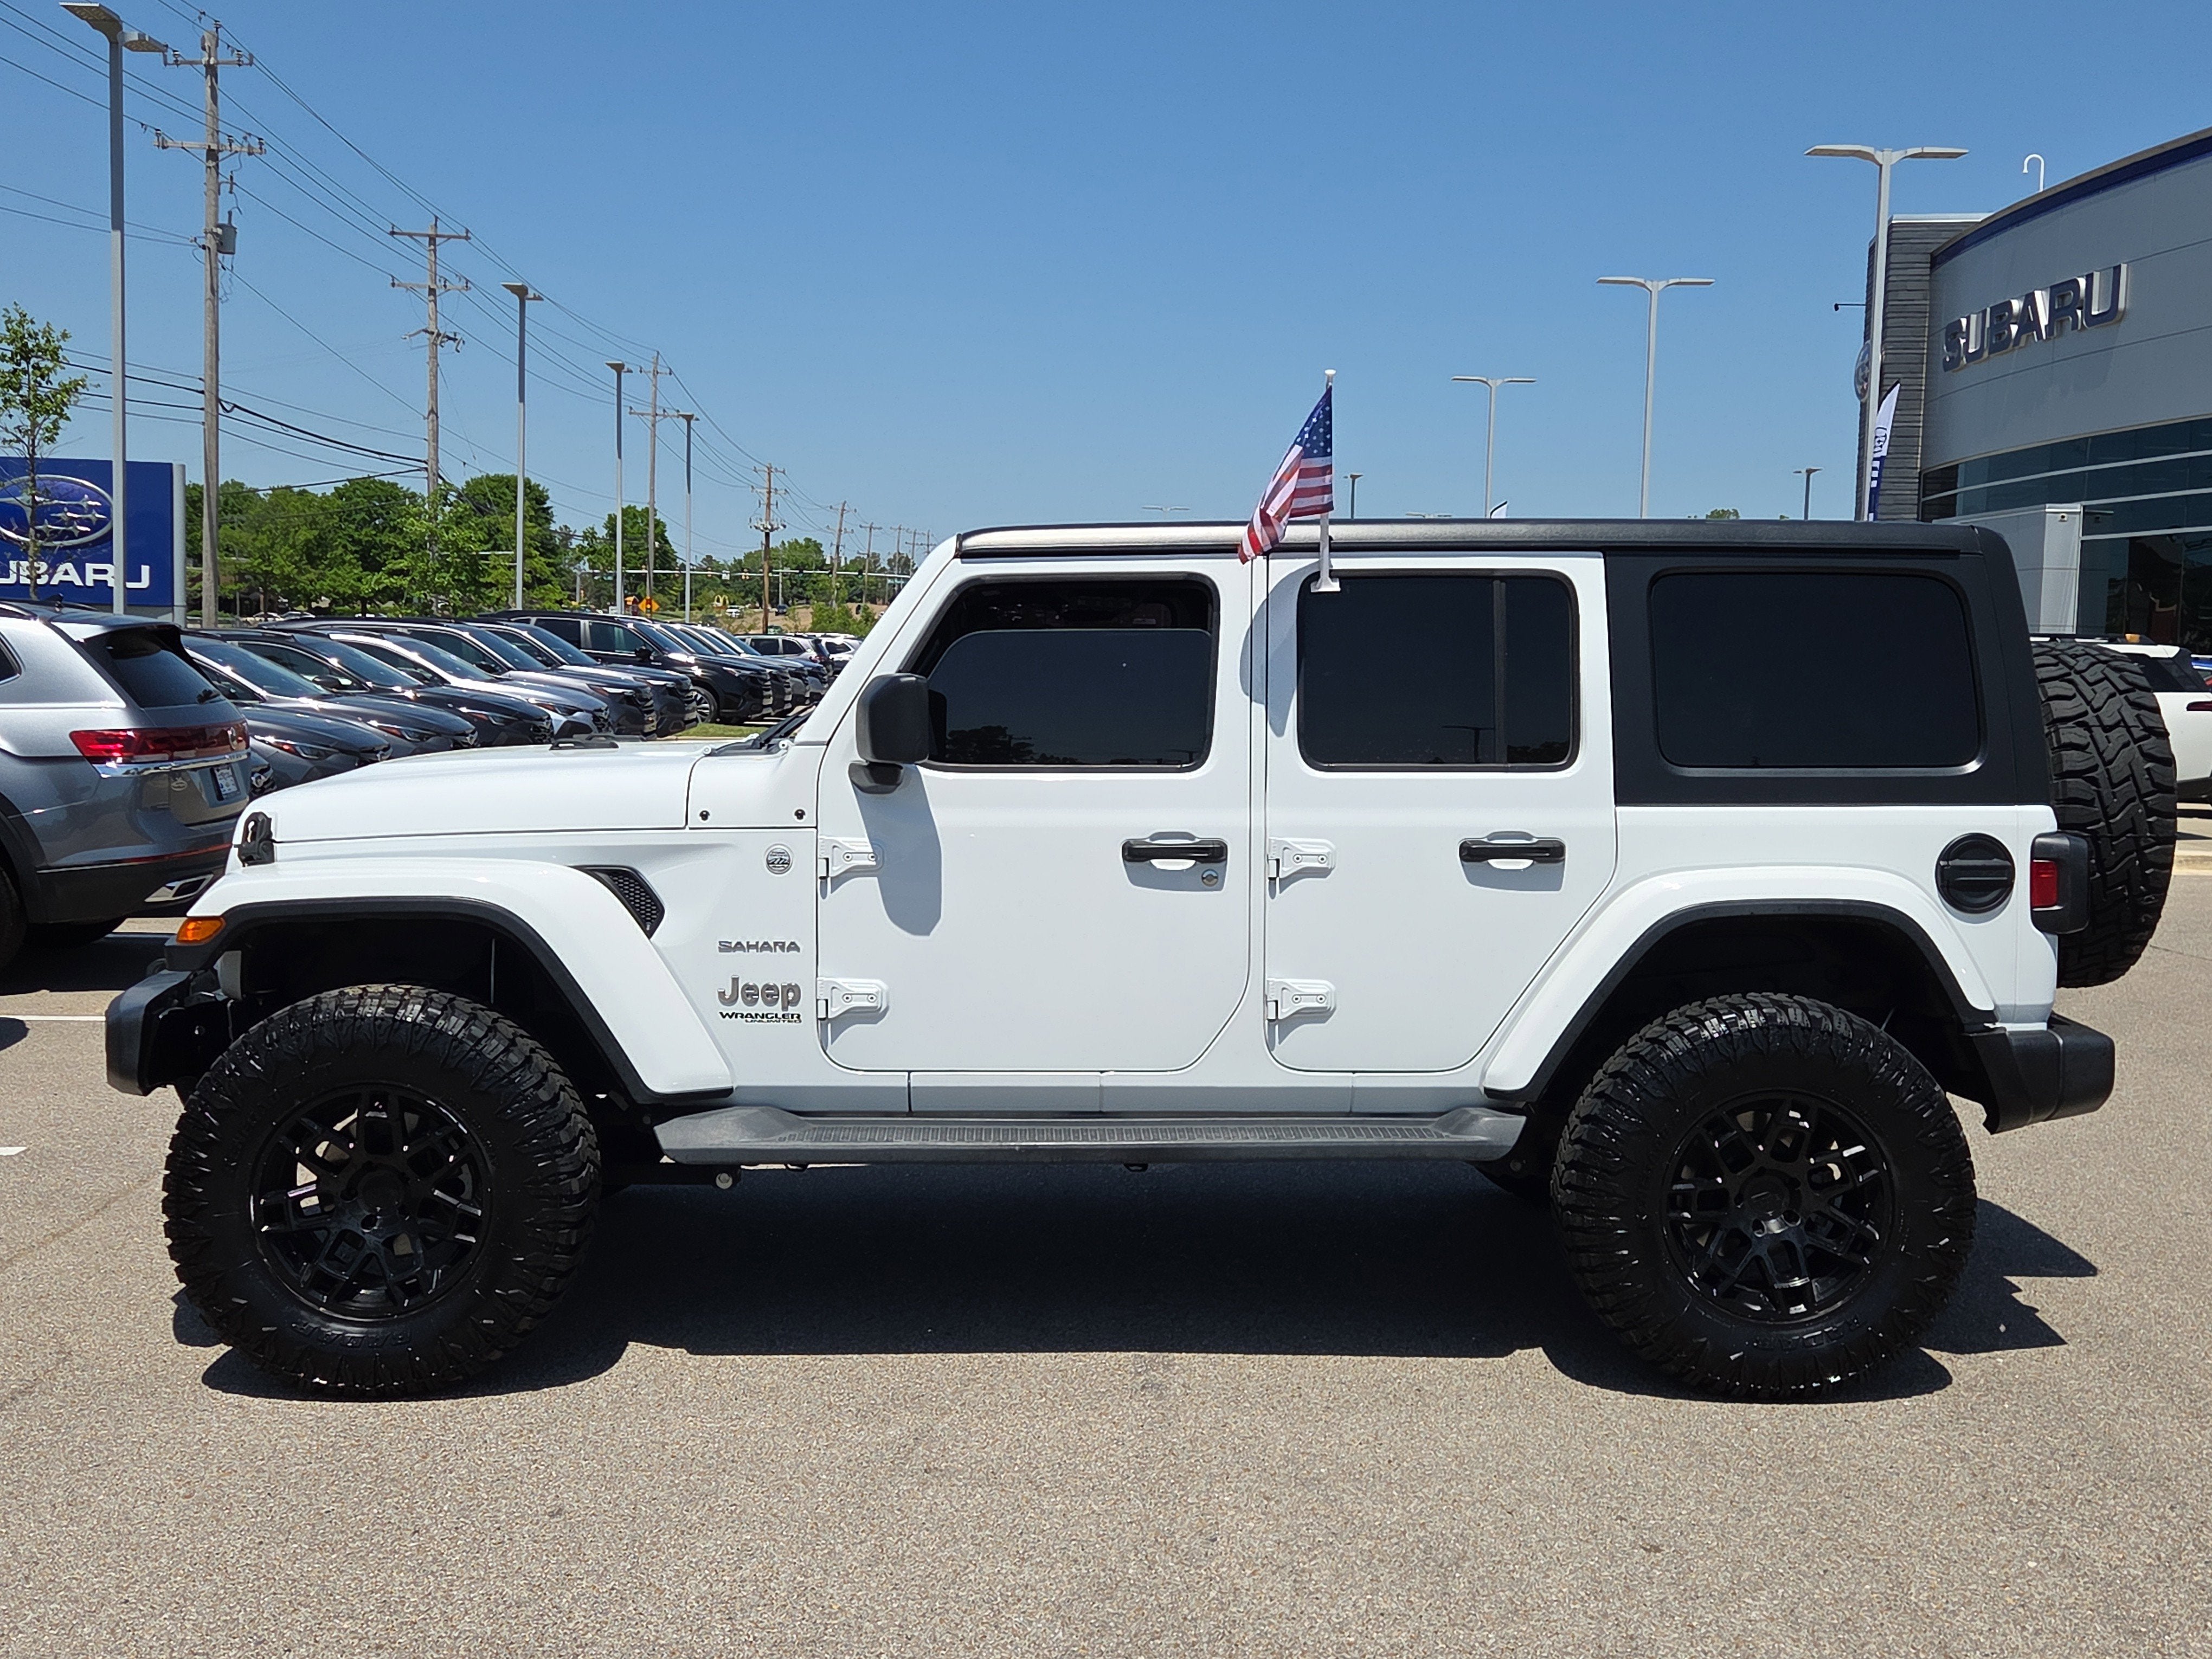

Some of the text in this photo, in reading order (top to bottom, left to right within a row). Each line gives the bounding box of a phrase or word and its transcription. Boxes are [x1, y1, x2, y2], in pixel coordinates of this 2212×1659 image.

[1942, 263, 2128, 372] SUBARU
[718, 940, 801, 953] SAHARA
[717, 975, 801, 1012] Jeep
[719, 1011, 801, 1020] WRANGLER
